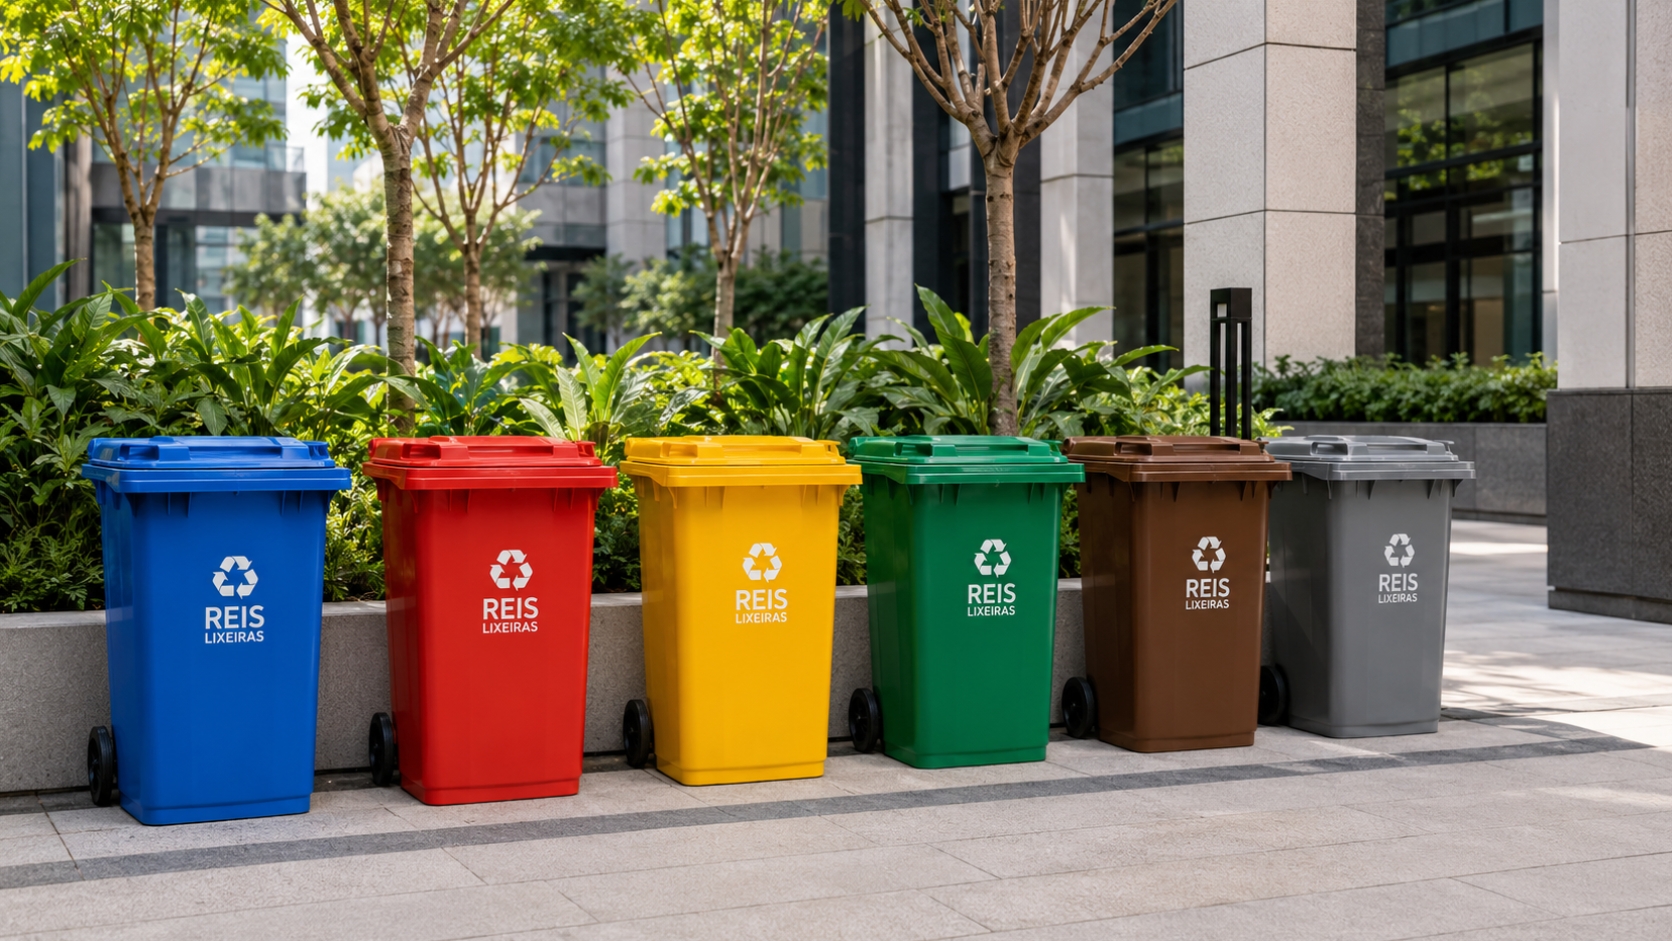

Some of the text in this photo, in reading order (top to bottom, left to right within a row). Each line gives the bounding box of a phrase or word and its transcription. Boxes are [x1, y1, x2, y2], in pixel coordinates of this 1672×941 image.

[1186, 578, 1229, 597] REIS
[1379, 573, 1418, 591] REIS
[736, 589, 788, 610] REIS
[968, 583, 1016, 604] REIS
[1379, 593, 1417, 603] LIXEIRAS
[483, 597, 538, 619] REIS
[968, 606, 1015, 616] LIXEIRAS
[1186, 599, 1229, 609] LIXEIRAS
[206, 605, 264, 629] REIS
[736, 612, 787, 623] LIXEIRAS
[483, 621, 538, 633] LIXEIRAS
[205, 631, 264, 643] LIXEIRAS
